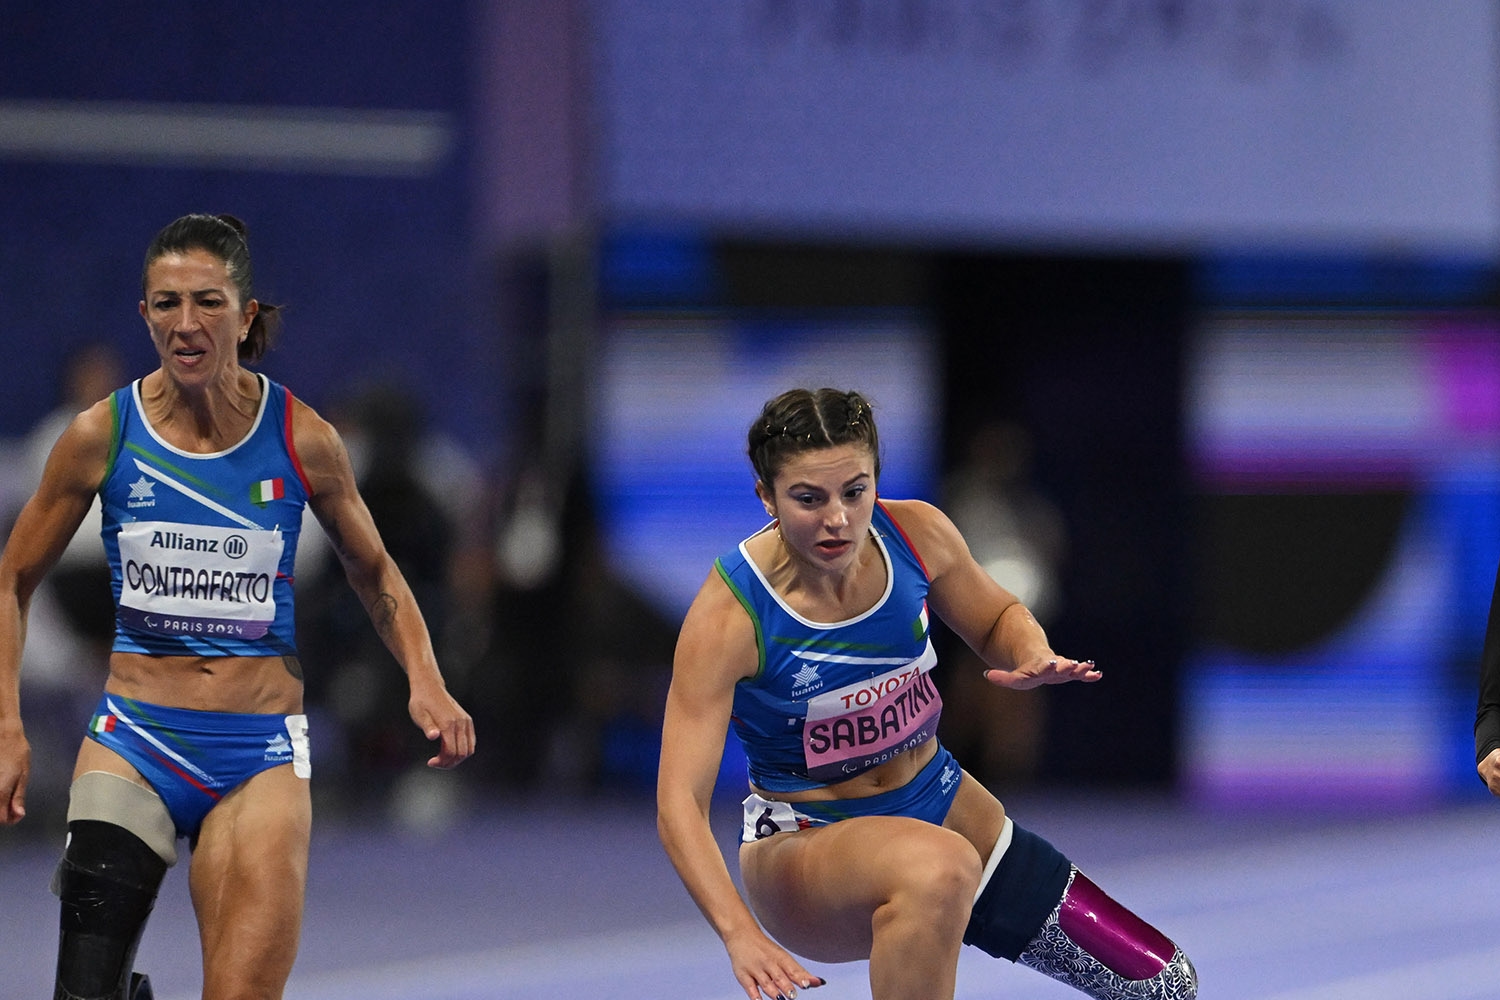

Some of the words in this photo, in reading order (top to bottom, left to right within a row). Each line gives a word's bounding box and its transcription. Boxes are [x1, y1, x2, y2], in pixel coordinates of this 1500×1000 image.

[150, 531, 219, 553] Allianz
[126, 559, 270, 603] CONTRAFATTO
[164, 620, 203, 632] PARIS
[207, 623, 243, 635] 2024
[791, 680, 825, 698] luanvi
[840, 666, 921, 710] TOYOTA
[809, 669, 936, 755] SABATINI
[864, 749, 901, 767] PARIS
[903, 730, 928, 752] 2024
[754, 807, 782, 840] 6
